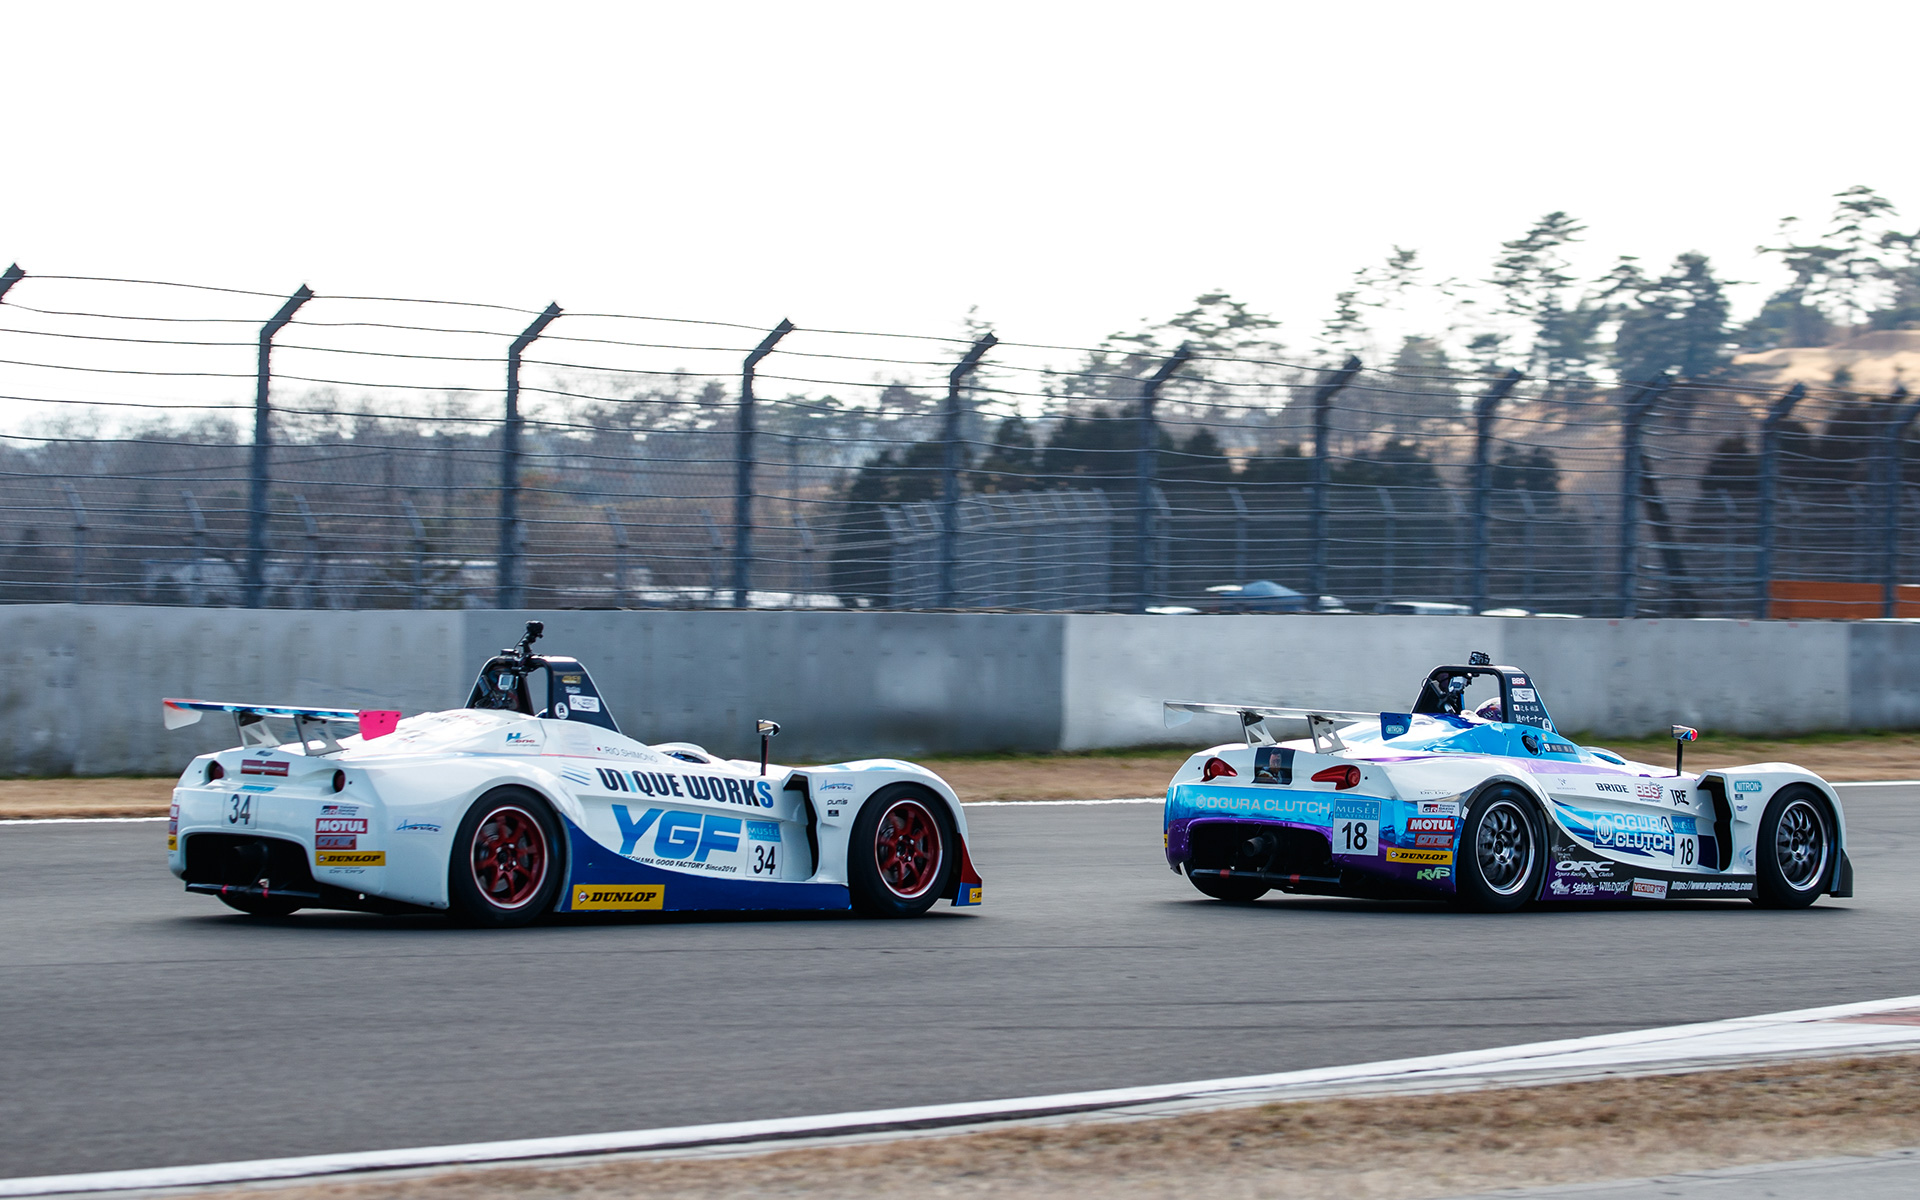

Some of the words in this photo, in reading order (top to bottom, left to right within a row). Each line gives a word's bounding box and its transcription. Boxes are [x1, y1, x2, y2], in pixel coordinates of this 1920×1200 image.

[682, 774, 774, 809] WORKS
[1595, 782, 1629, 794] BRIDE
[1635, 783, 1660, 799] BBS
[229, 794, 251, 825] 34
[1207, 796, 1260, 811] OGURA
[1264, 799, 1330, 814] CLUTCH
[316, 820, 366, 832] MOTUL
[1410, 819, 1453, 830] MOTUL
[1613, 814, 1673, 834] OGURA
[611, 804, 743, 863] YGF
[1342, 821, 1367, 850] 18
[1615, 832, 1673, 850] CLUTCH
[753, 845, 776, 875] 34
[1680, 838, 1693, 865] 18
[655, 858, 674, 867] GOOD
[675, 861, 704, 869] FACTORY
[1555, 861, 1615, 878] ORC
[1634, 883, 1654, 892] VECTOR
[590, 892, 657, 902] DUNLOP
